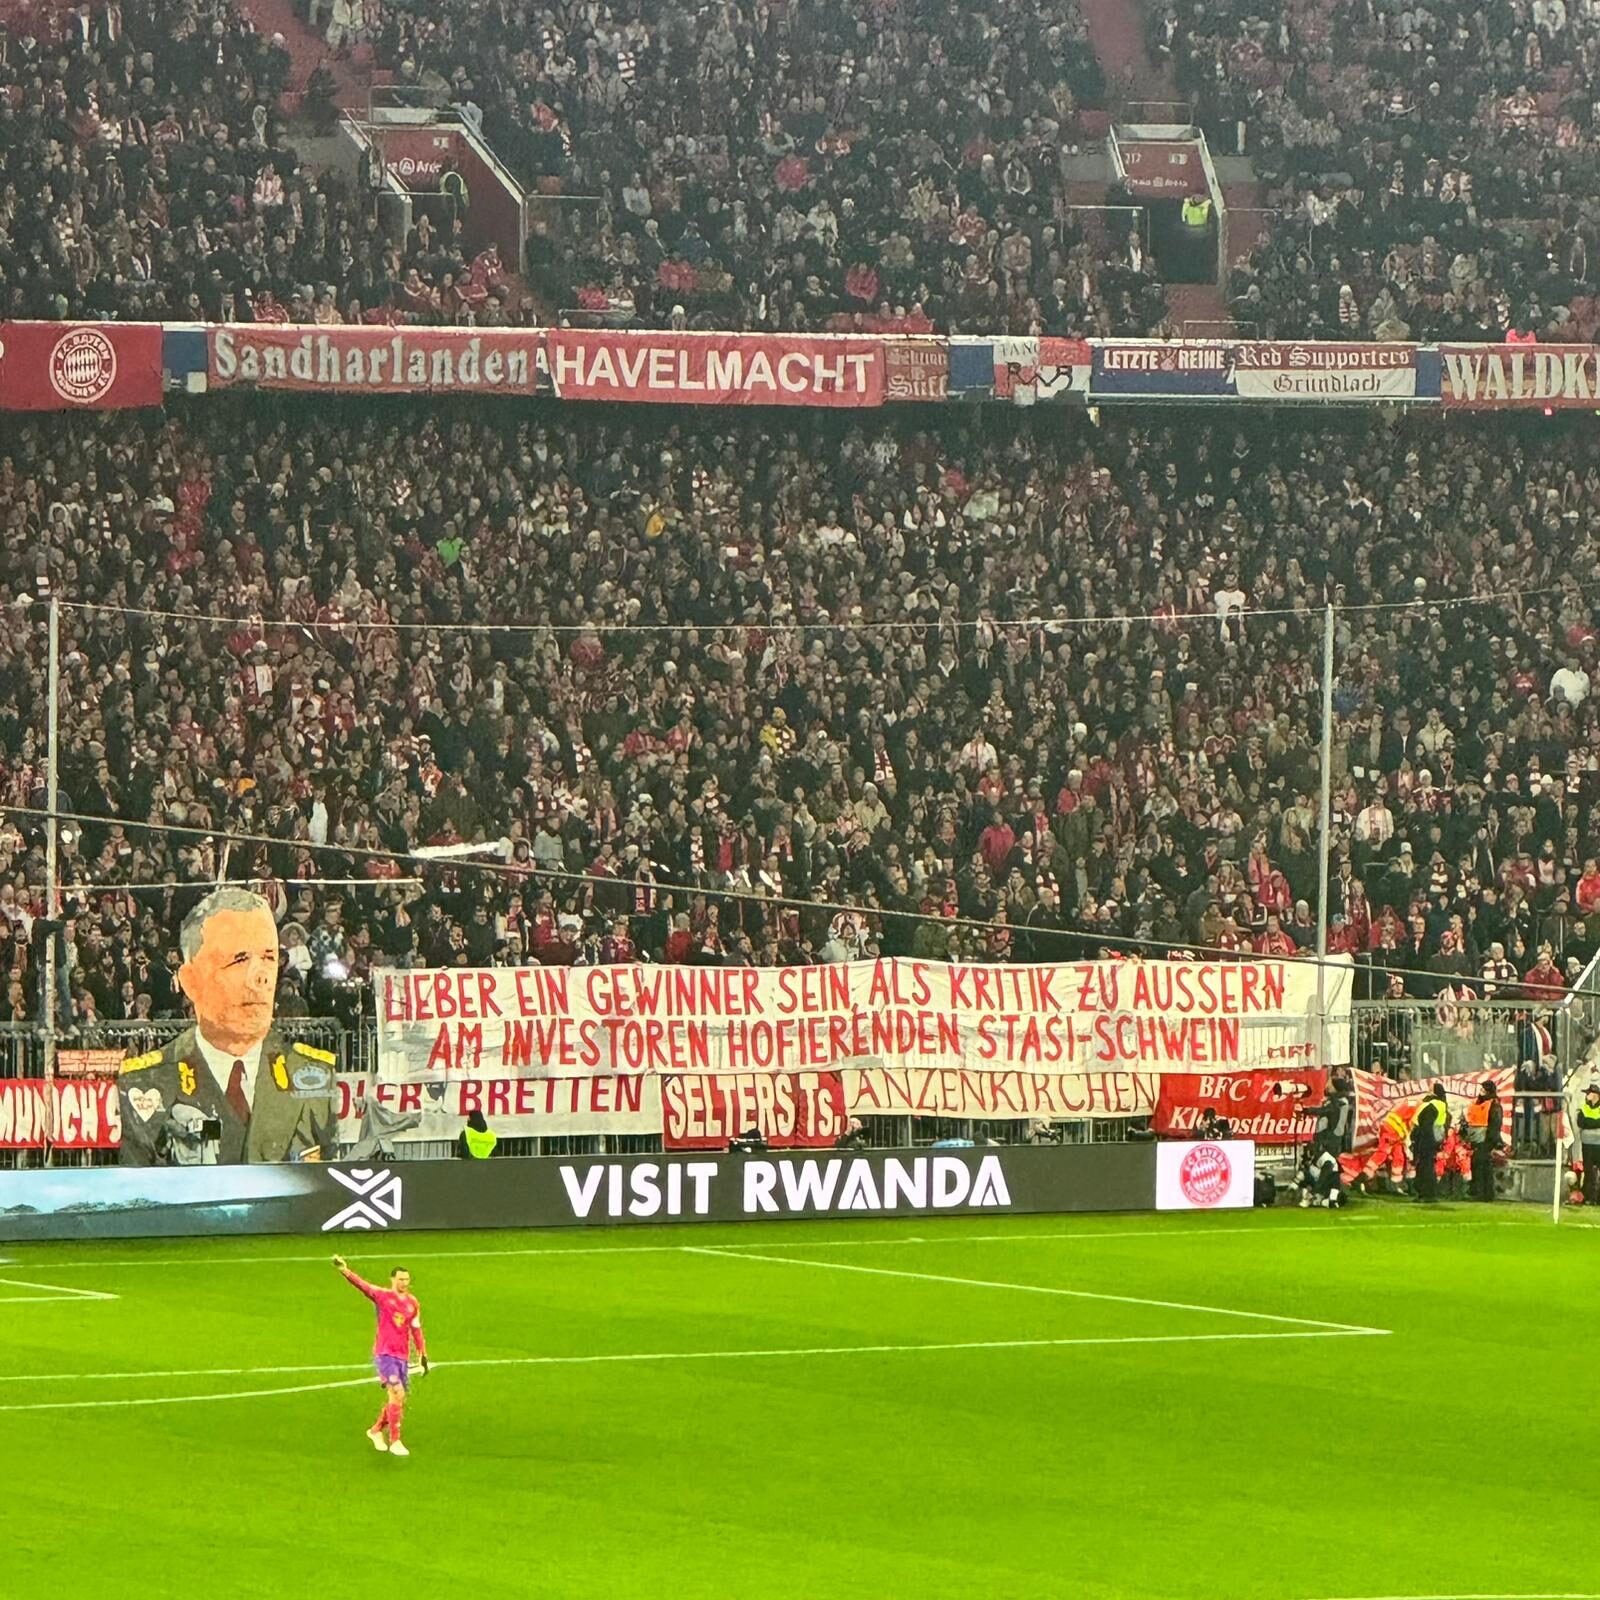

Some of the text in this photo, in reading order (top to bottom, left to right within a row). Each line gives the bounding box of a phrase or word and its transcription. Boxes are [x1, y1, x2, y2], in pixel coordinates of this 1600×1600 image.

[214, 333, 528, 384] Sandharlanden
[556, 346, 874, 393] HAVELMACHT
[1103, 350, 1158, 369] LETZTE
[1237, 345, 1410, 369] Red Supporters
[1444, 352, 1600, 400] WALDK
[384, 972, 503, 1022] LIEBER
[515, 967, 569, 1017] EIN
[586, 967, 765, 1017] GEWINNER
[868, 957, 931, 1007] ALS
[948, 964, 1062, 1013] KRITIK
[1075, 965, 1119, 1012] ZU
[427, 1009, 1240, 1069] AM INVESTOREN HOFIERENDEN STASI-SCHWEIN
[665, 1073, 795, 1139] SELTERS
[850, 1068, 1160, 1113] ANZENKIRCHEN
[1199, 1075, 1251, 1101] BFC
[559, 1154, 1012, 1218] VISIT RWANDA
